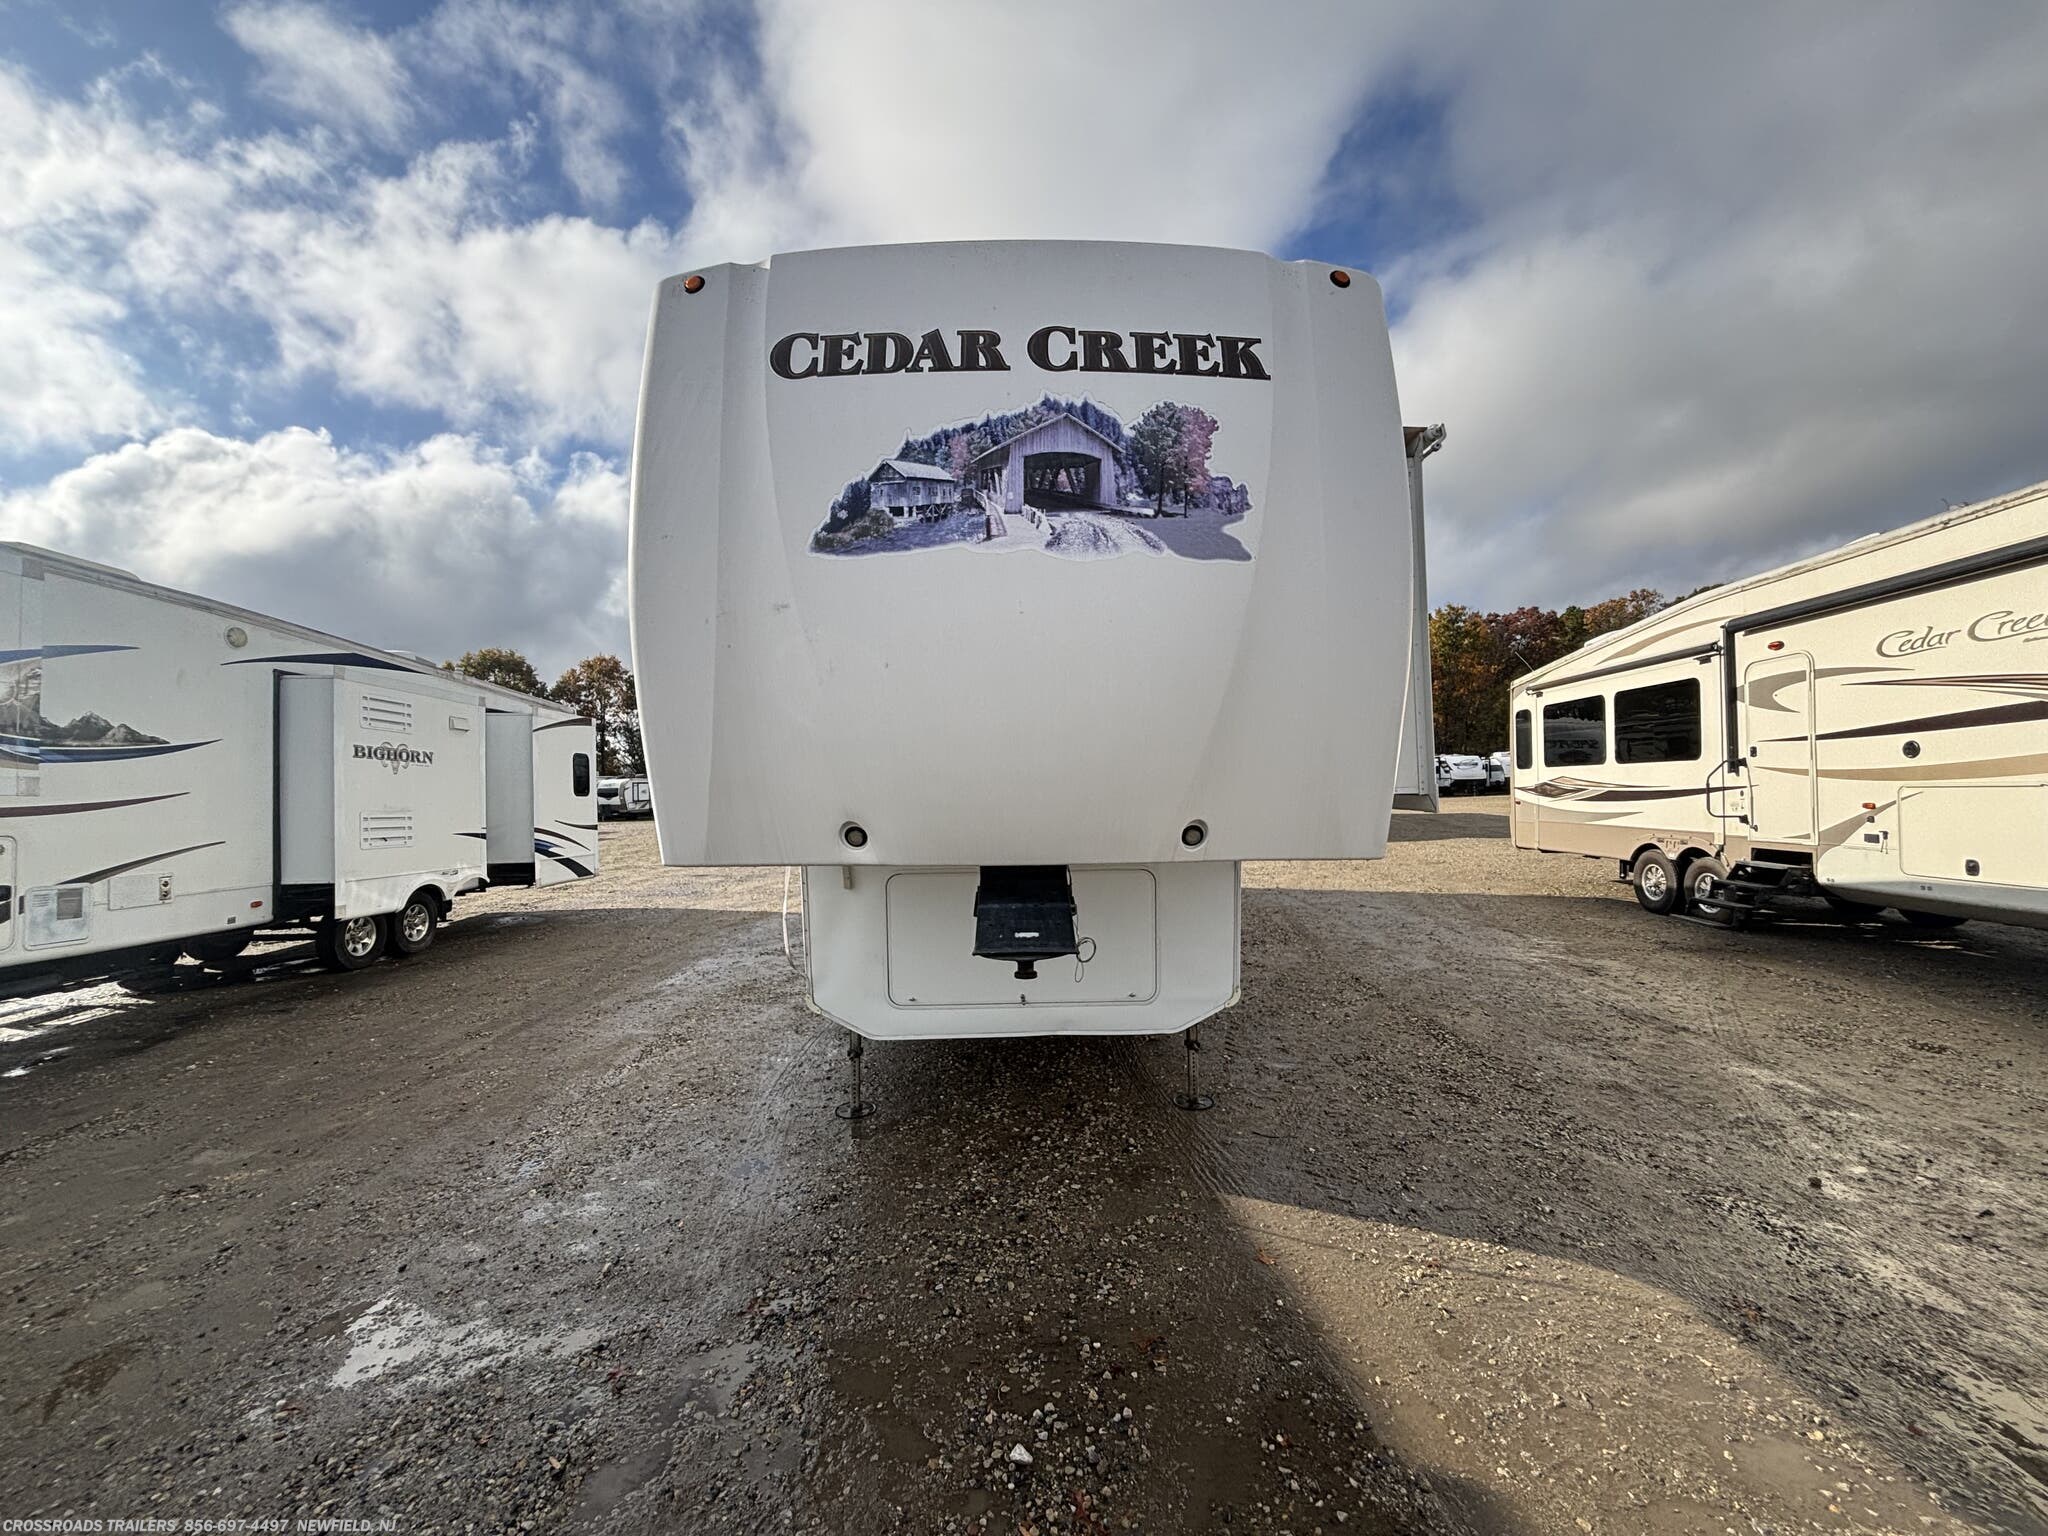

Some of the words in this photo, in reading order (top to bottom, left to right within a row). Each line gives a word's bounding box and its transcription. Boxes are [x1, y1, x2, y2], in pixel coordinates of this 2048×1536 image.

[769, 328, 1010, 380] CEDAR
[1027, 325, 1271, 380] CREEK
[1876, 626, 1962, 659] Cedar
[1967, 610, 2048, 642] Cree
[352, 744, 434, 765] BIGHORN
